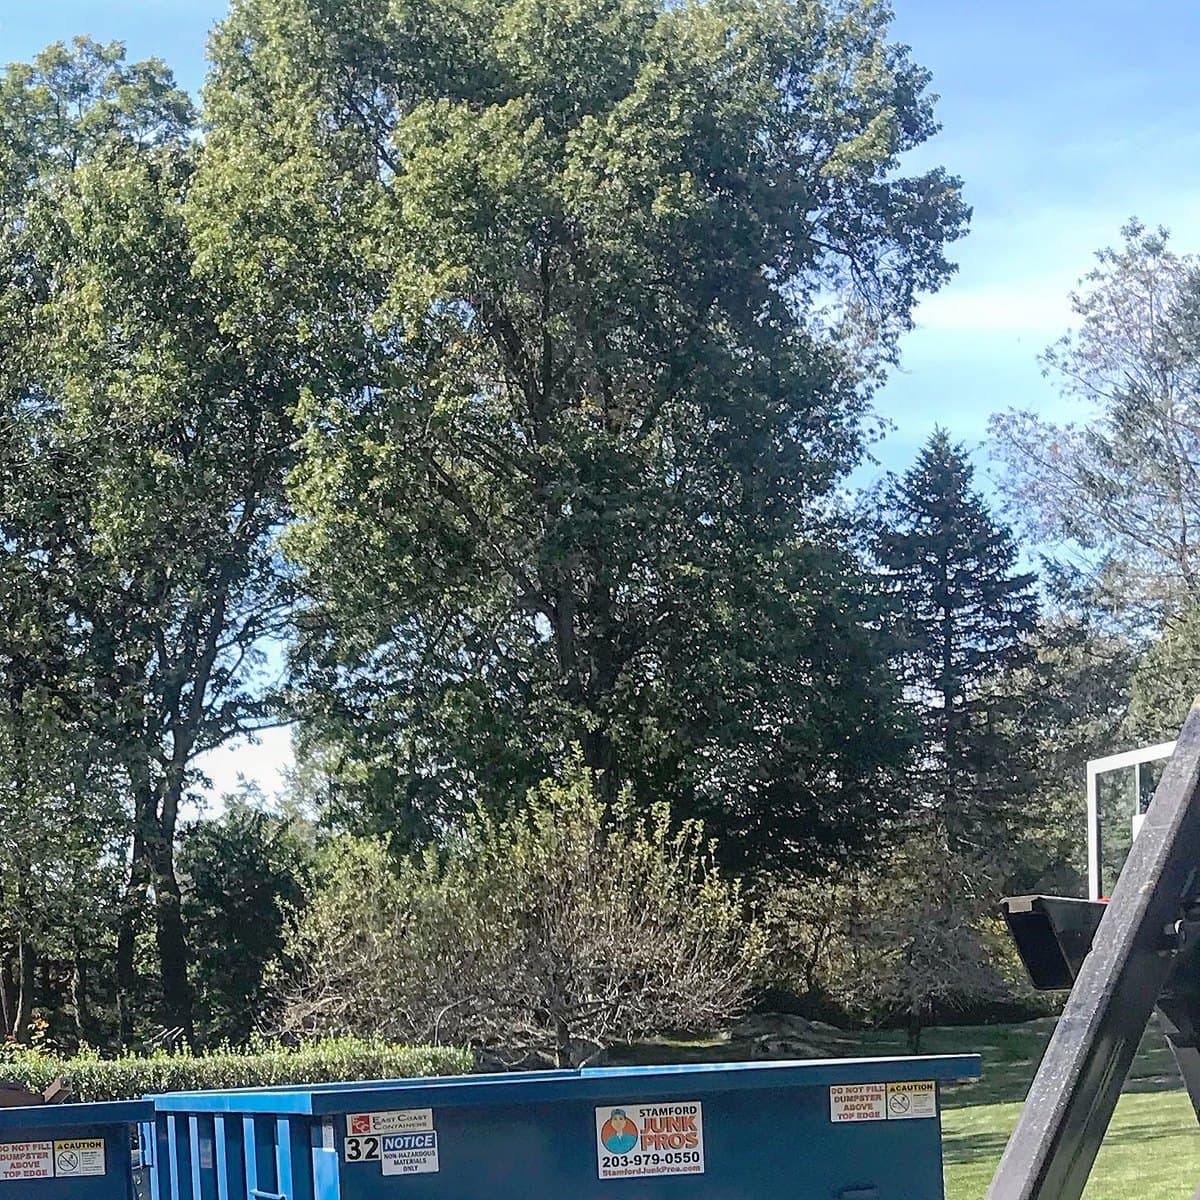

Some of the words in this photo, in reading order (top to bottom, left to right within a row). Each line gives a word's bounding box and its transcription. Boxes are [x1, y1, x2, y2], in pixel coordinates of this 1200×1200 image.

[896, 1084, 933, 1092] CAUTION
[834, 1094, 882, 1103] DUMPSTER
[639, 1106, 697, 1117] STAMFORD
[843, 1103, 874, 1111] ABOVE
[640, 1115, 698, 1134] JUNK
[384, 1135, 433, 1150] NOTICE
[641, 1132, 699, 1151] PROS
[347, 1137, 379, 1160] 32
[0, 1152, 49, 1161] DUMPSTER
[602, 1151, 700, 1168] 203-979-0550
[10, 1161, 40, 1169] ABOVE
[602, 1165, 701, 1176] StamfordJunkPros.com
[23, 1169, 48, 1177] EDGE
